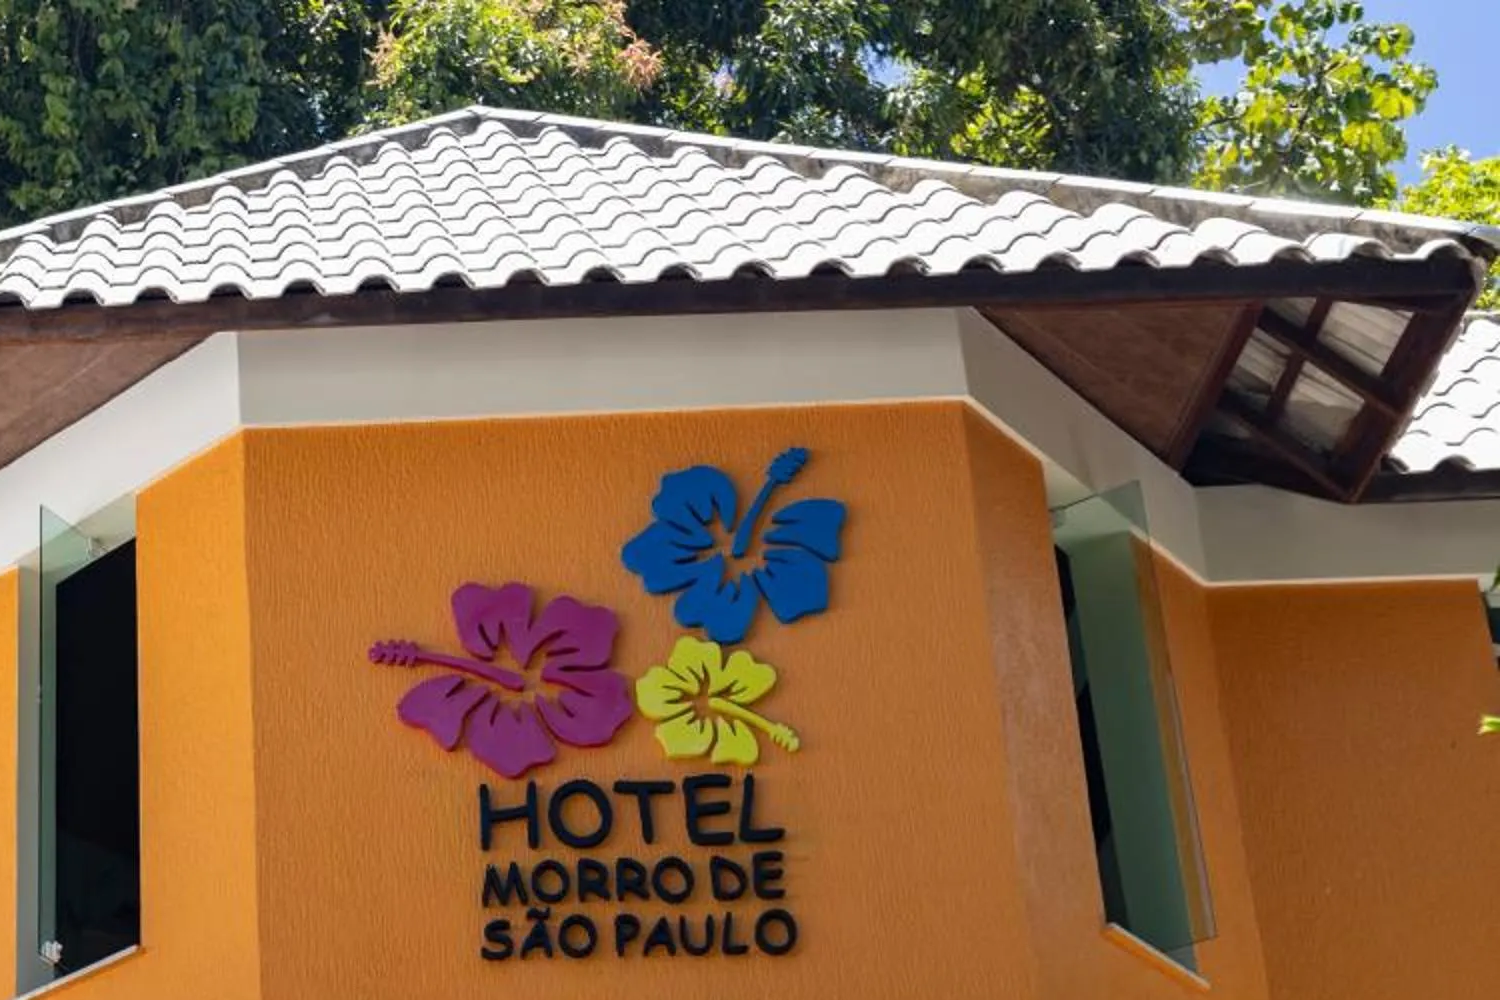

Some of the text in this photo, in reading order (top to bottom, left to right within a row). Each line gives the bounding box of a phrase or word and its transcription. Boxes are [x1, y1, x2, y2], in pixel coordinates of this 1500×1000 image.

[479, 773, 786, 851] HOTEL
[481, 850, 786, 908] MORRO DE
[481, 906, 798, 961] SÃO PAULO
